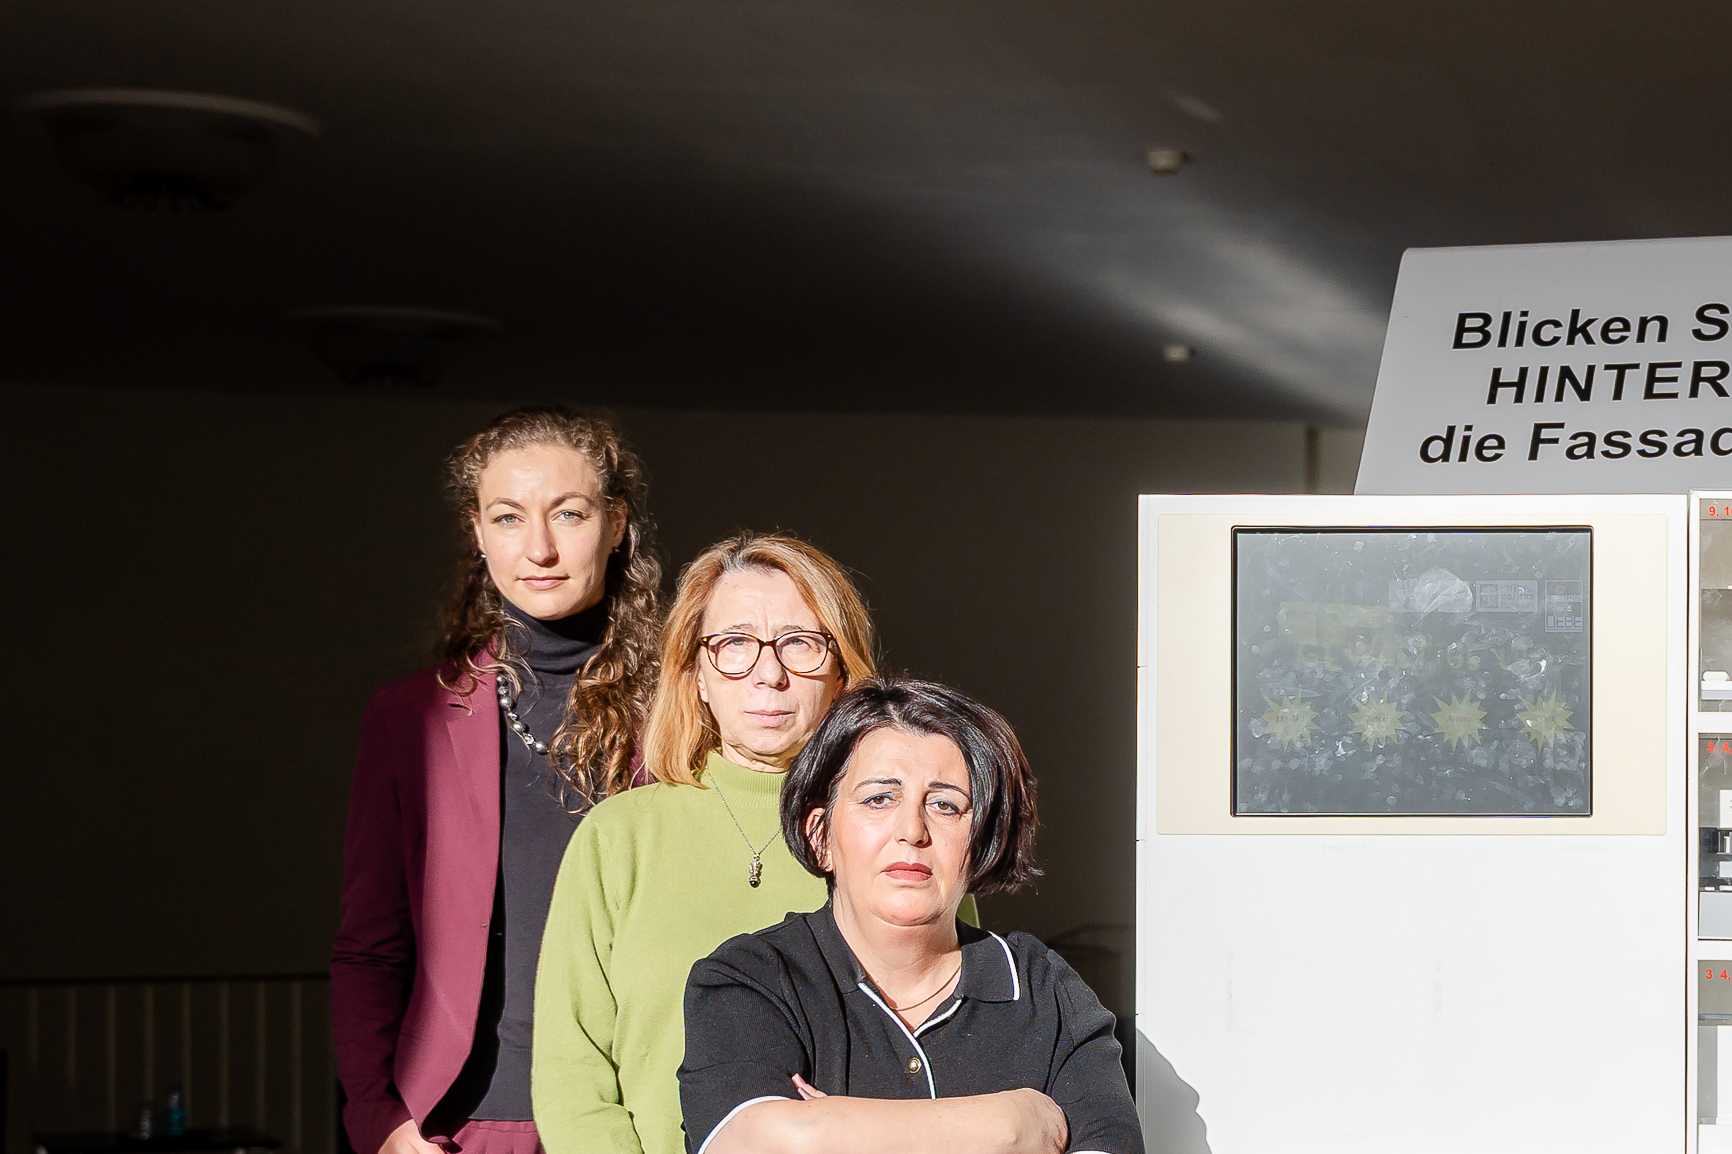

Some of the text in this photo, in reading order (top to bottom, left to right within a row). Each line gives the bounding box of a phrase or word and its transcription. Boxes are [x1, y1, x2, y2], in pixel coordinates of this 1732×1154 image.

[1452, 308, 1669, 350] Blicken
[1486, 361, 1730, 405] HINTER
[1419, 424, 1506, 464] die
[1708, 506, 1719, 518] 9,
[1446, 715, 1472, 723] Audio
[1706, 741, 1718, 754] 3,
[1722, 741, 1732, 754] 4,
[1720, 968, 1731, 982] 4,
